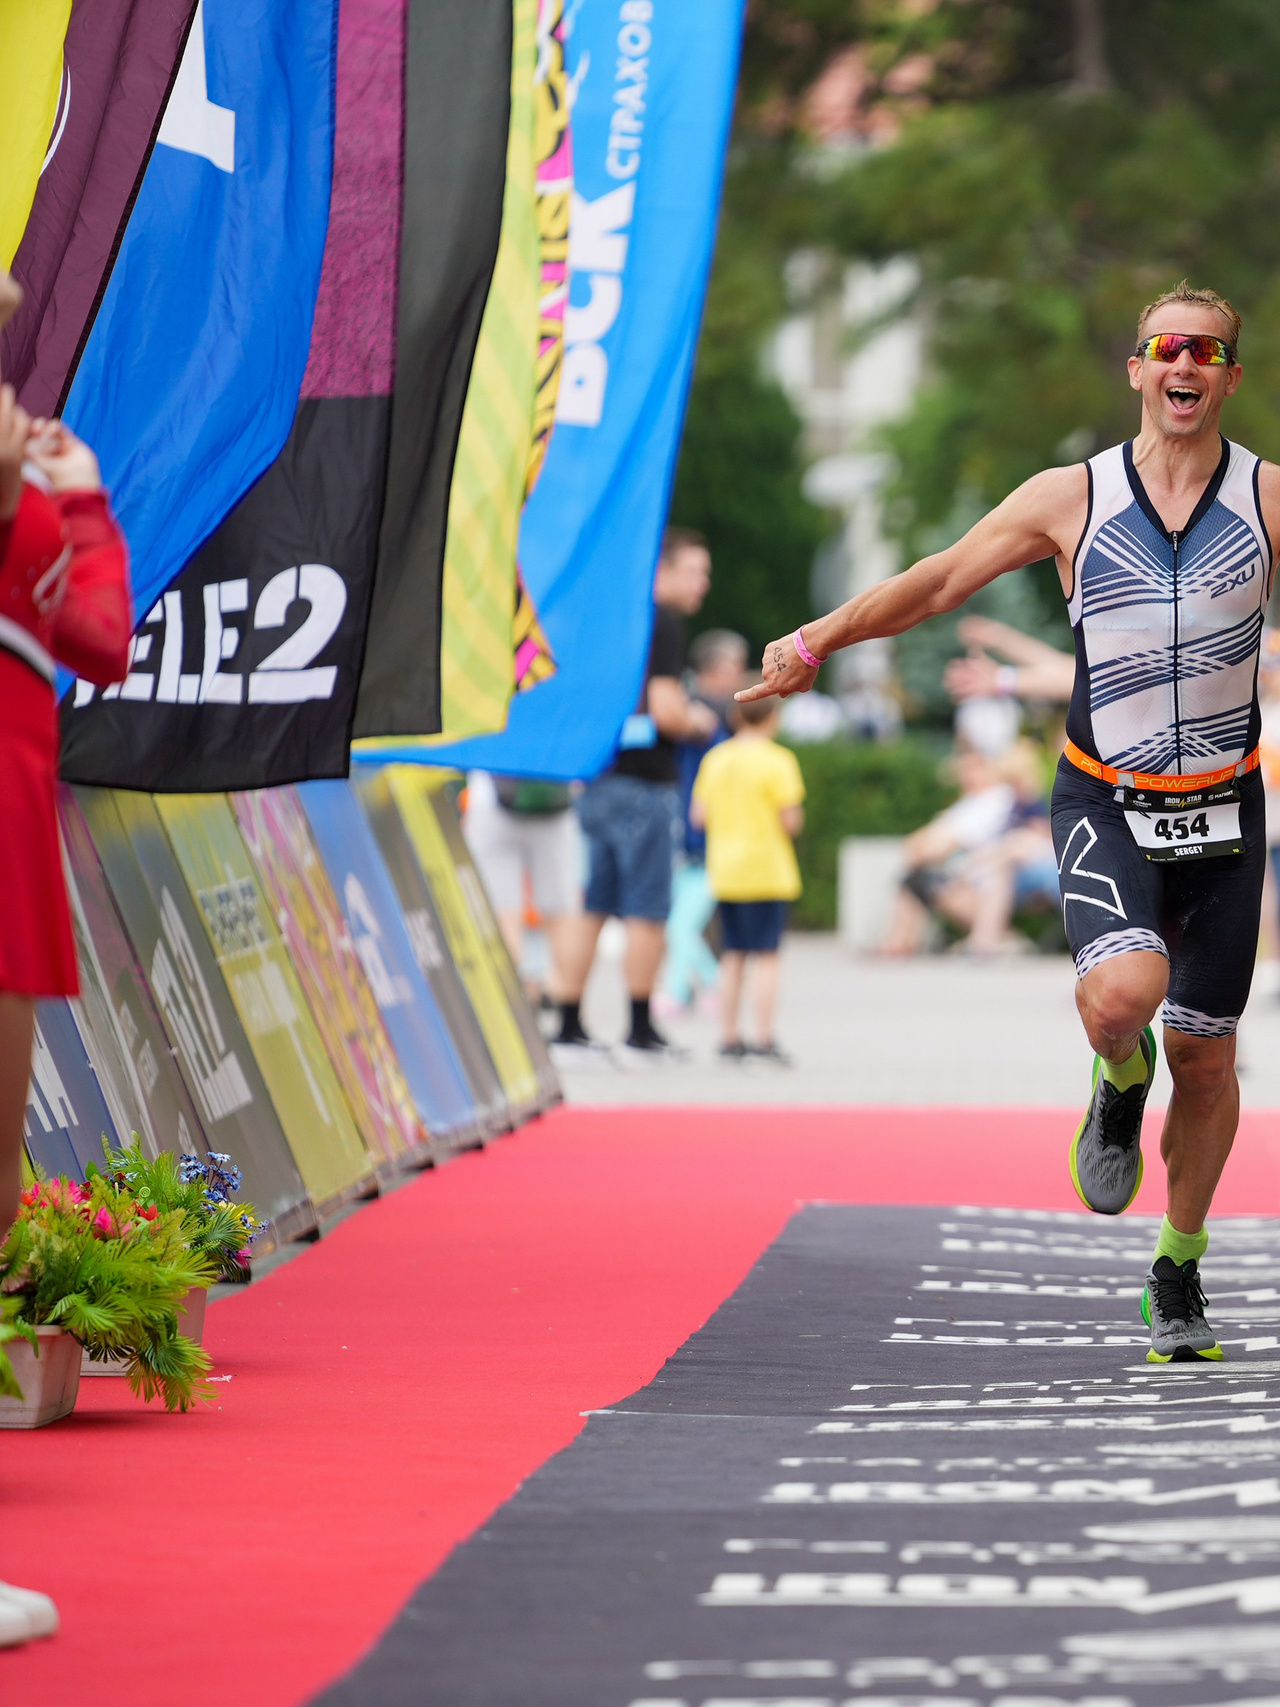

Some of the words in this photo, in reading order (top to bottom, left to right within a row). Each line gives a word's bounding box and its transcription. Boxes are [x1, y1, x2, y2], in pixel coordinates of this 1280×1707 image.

[1210, 563, 1256, 600] 2XU
[73, 563, 347, 708] ELE2
[773, 646, 787, 673] 454
[1134, 768, 1235, 788] POWERUP
[1186, 794, 1202, 803] STAR
[1154, 812, 1210, 840] 454
[1174, 845, 1203, 857] SERGEY
[838, 1394, 1161, 1409] IRON
[814, 1417, 1154, 1430] IRON
